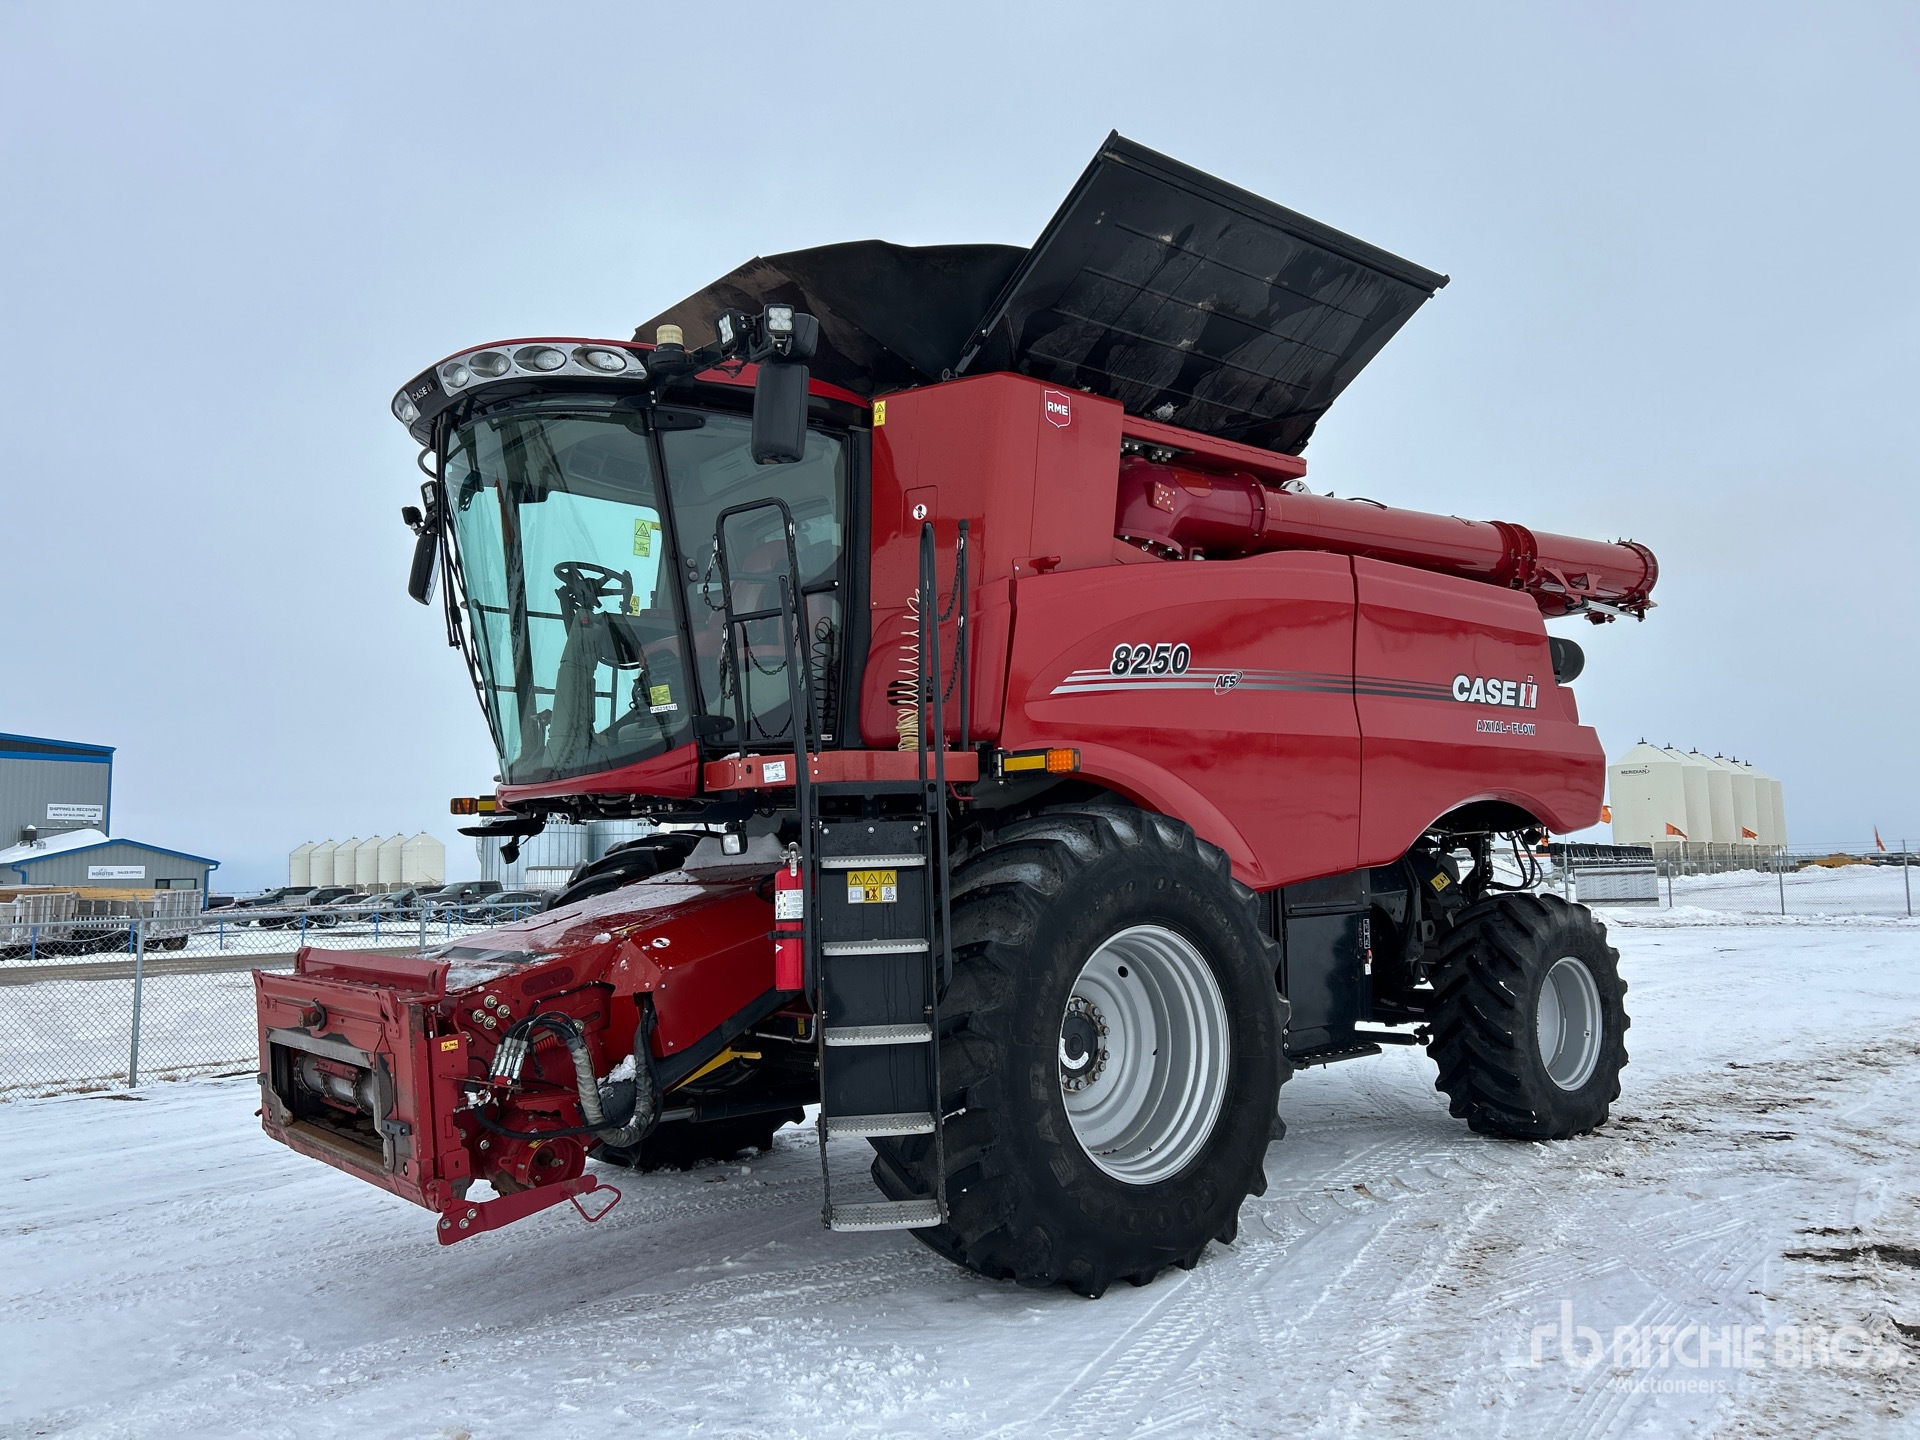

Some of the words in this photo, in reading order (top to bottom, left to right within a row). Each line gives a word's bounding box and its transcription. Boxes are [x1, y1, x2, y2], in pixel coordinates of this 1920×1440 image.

[412, 386, 428, 401] CASE
[1047, 401, 1069, 416] RME
[1110, 642, 1191, 677] 8250
[1215, 674, 1236, 688] AFS
[1452, 674, 1517, 706] CASE
[1476, 719, 1536, 736] AXIAL-FLOW
